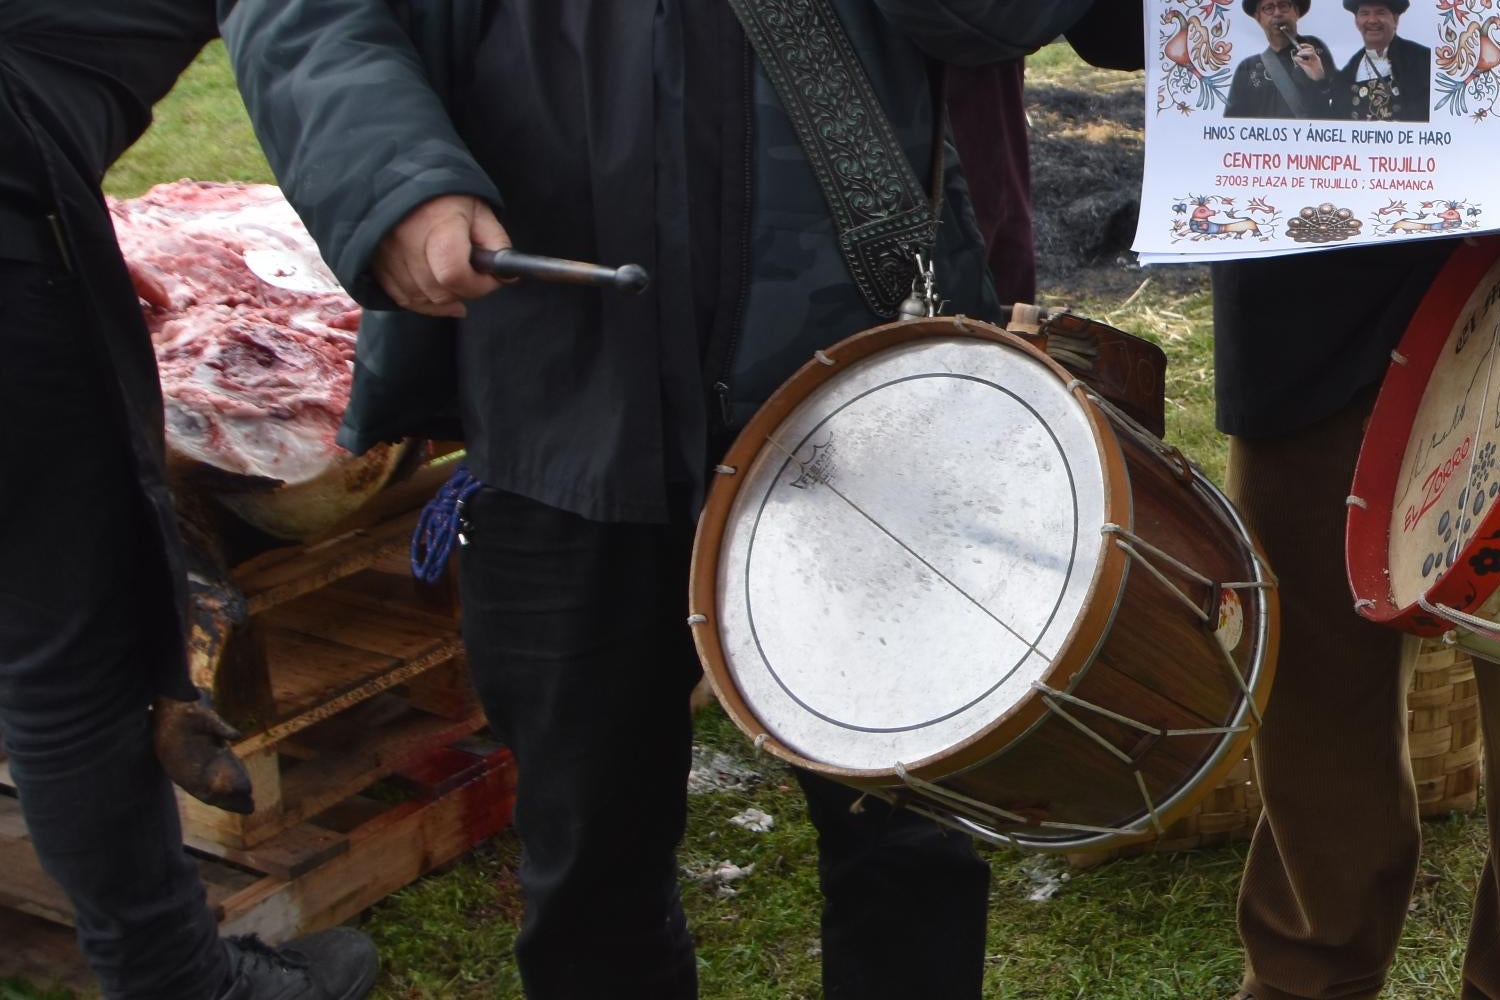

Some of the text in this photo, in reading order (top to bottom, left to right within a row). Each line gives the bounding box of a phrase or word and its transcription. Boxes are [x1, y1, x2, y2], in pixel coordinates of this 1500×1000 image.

[1203, 123, 1452, 146] HNOS CARLOS Y ÁNGEL RUFINO DE HARO
[1223, 152, 1436, 173] CENTRO MUNICIPAL TRUJILLO
[1215, 175, 1249, 187] 37003
[1252, 176, 1287, 188] PLAZA
[1291, 177, 1305, 188] DE
[1310, 178, 1358, 190] TRUJILLO
[1369, 179, 1434, 191] SALAMANCA
